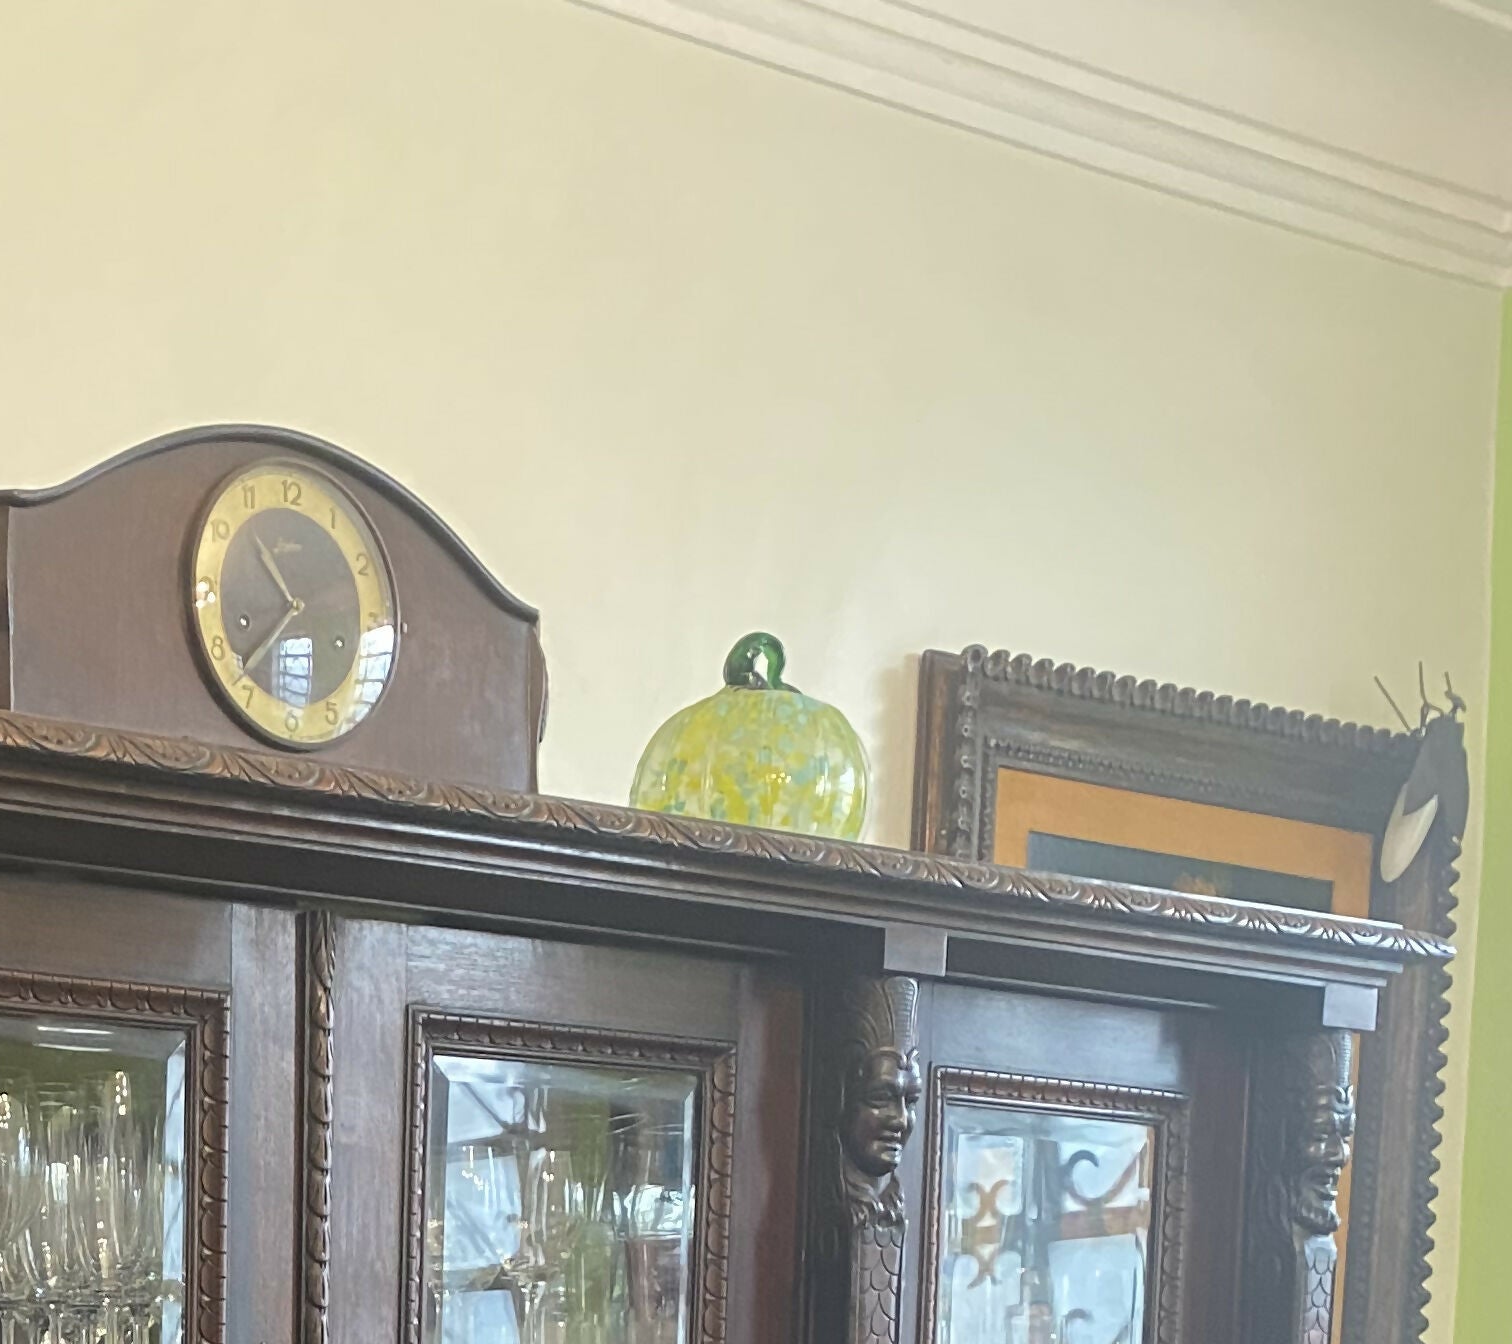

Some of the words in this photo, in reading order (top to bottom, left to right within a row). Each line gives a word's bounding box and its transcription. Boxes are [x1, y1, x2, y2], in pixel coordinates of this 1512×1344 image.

[241, 483, 256, 510] 11
[281, 479, 302, 506] 12
[210, 519, 230, 542] 10
[329, 506, 336, 530] 1
[356, 552, 369, 576] 2
[211, 635, 225, 661] 8
[241, 684, 255, 709] 7
[325, 701, 338, 726] 5
